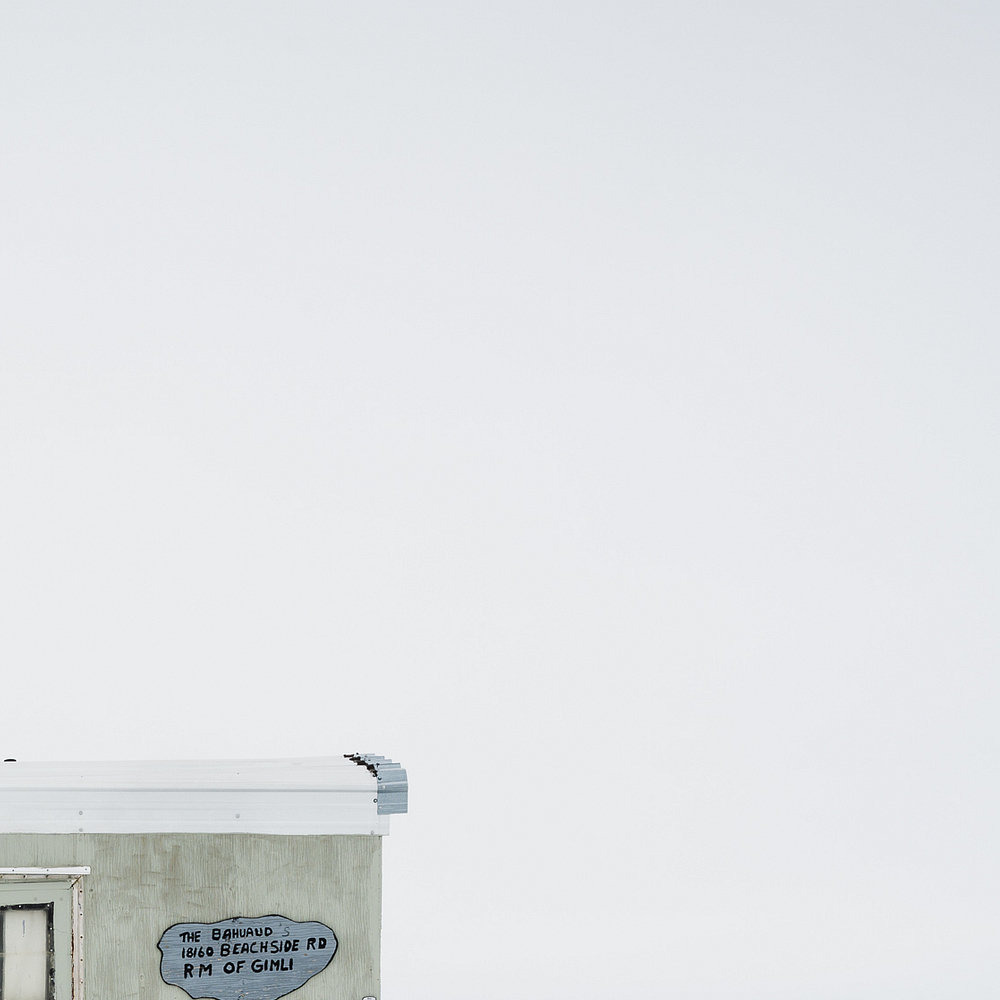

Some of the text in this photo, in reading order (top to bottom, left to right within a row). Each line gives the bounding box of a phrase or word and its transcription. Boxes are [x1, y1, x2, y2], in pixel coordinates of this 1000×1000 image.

[179, 931, 201, 943] THE
[182, 938, 327, 959] 18160 BEACHSIDE RD
[223, 961, 246, 974] OF
[251, 958, 294, 973] GIMLI
